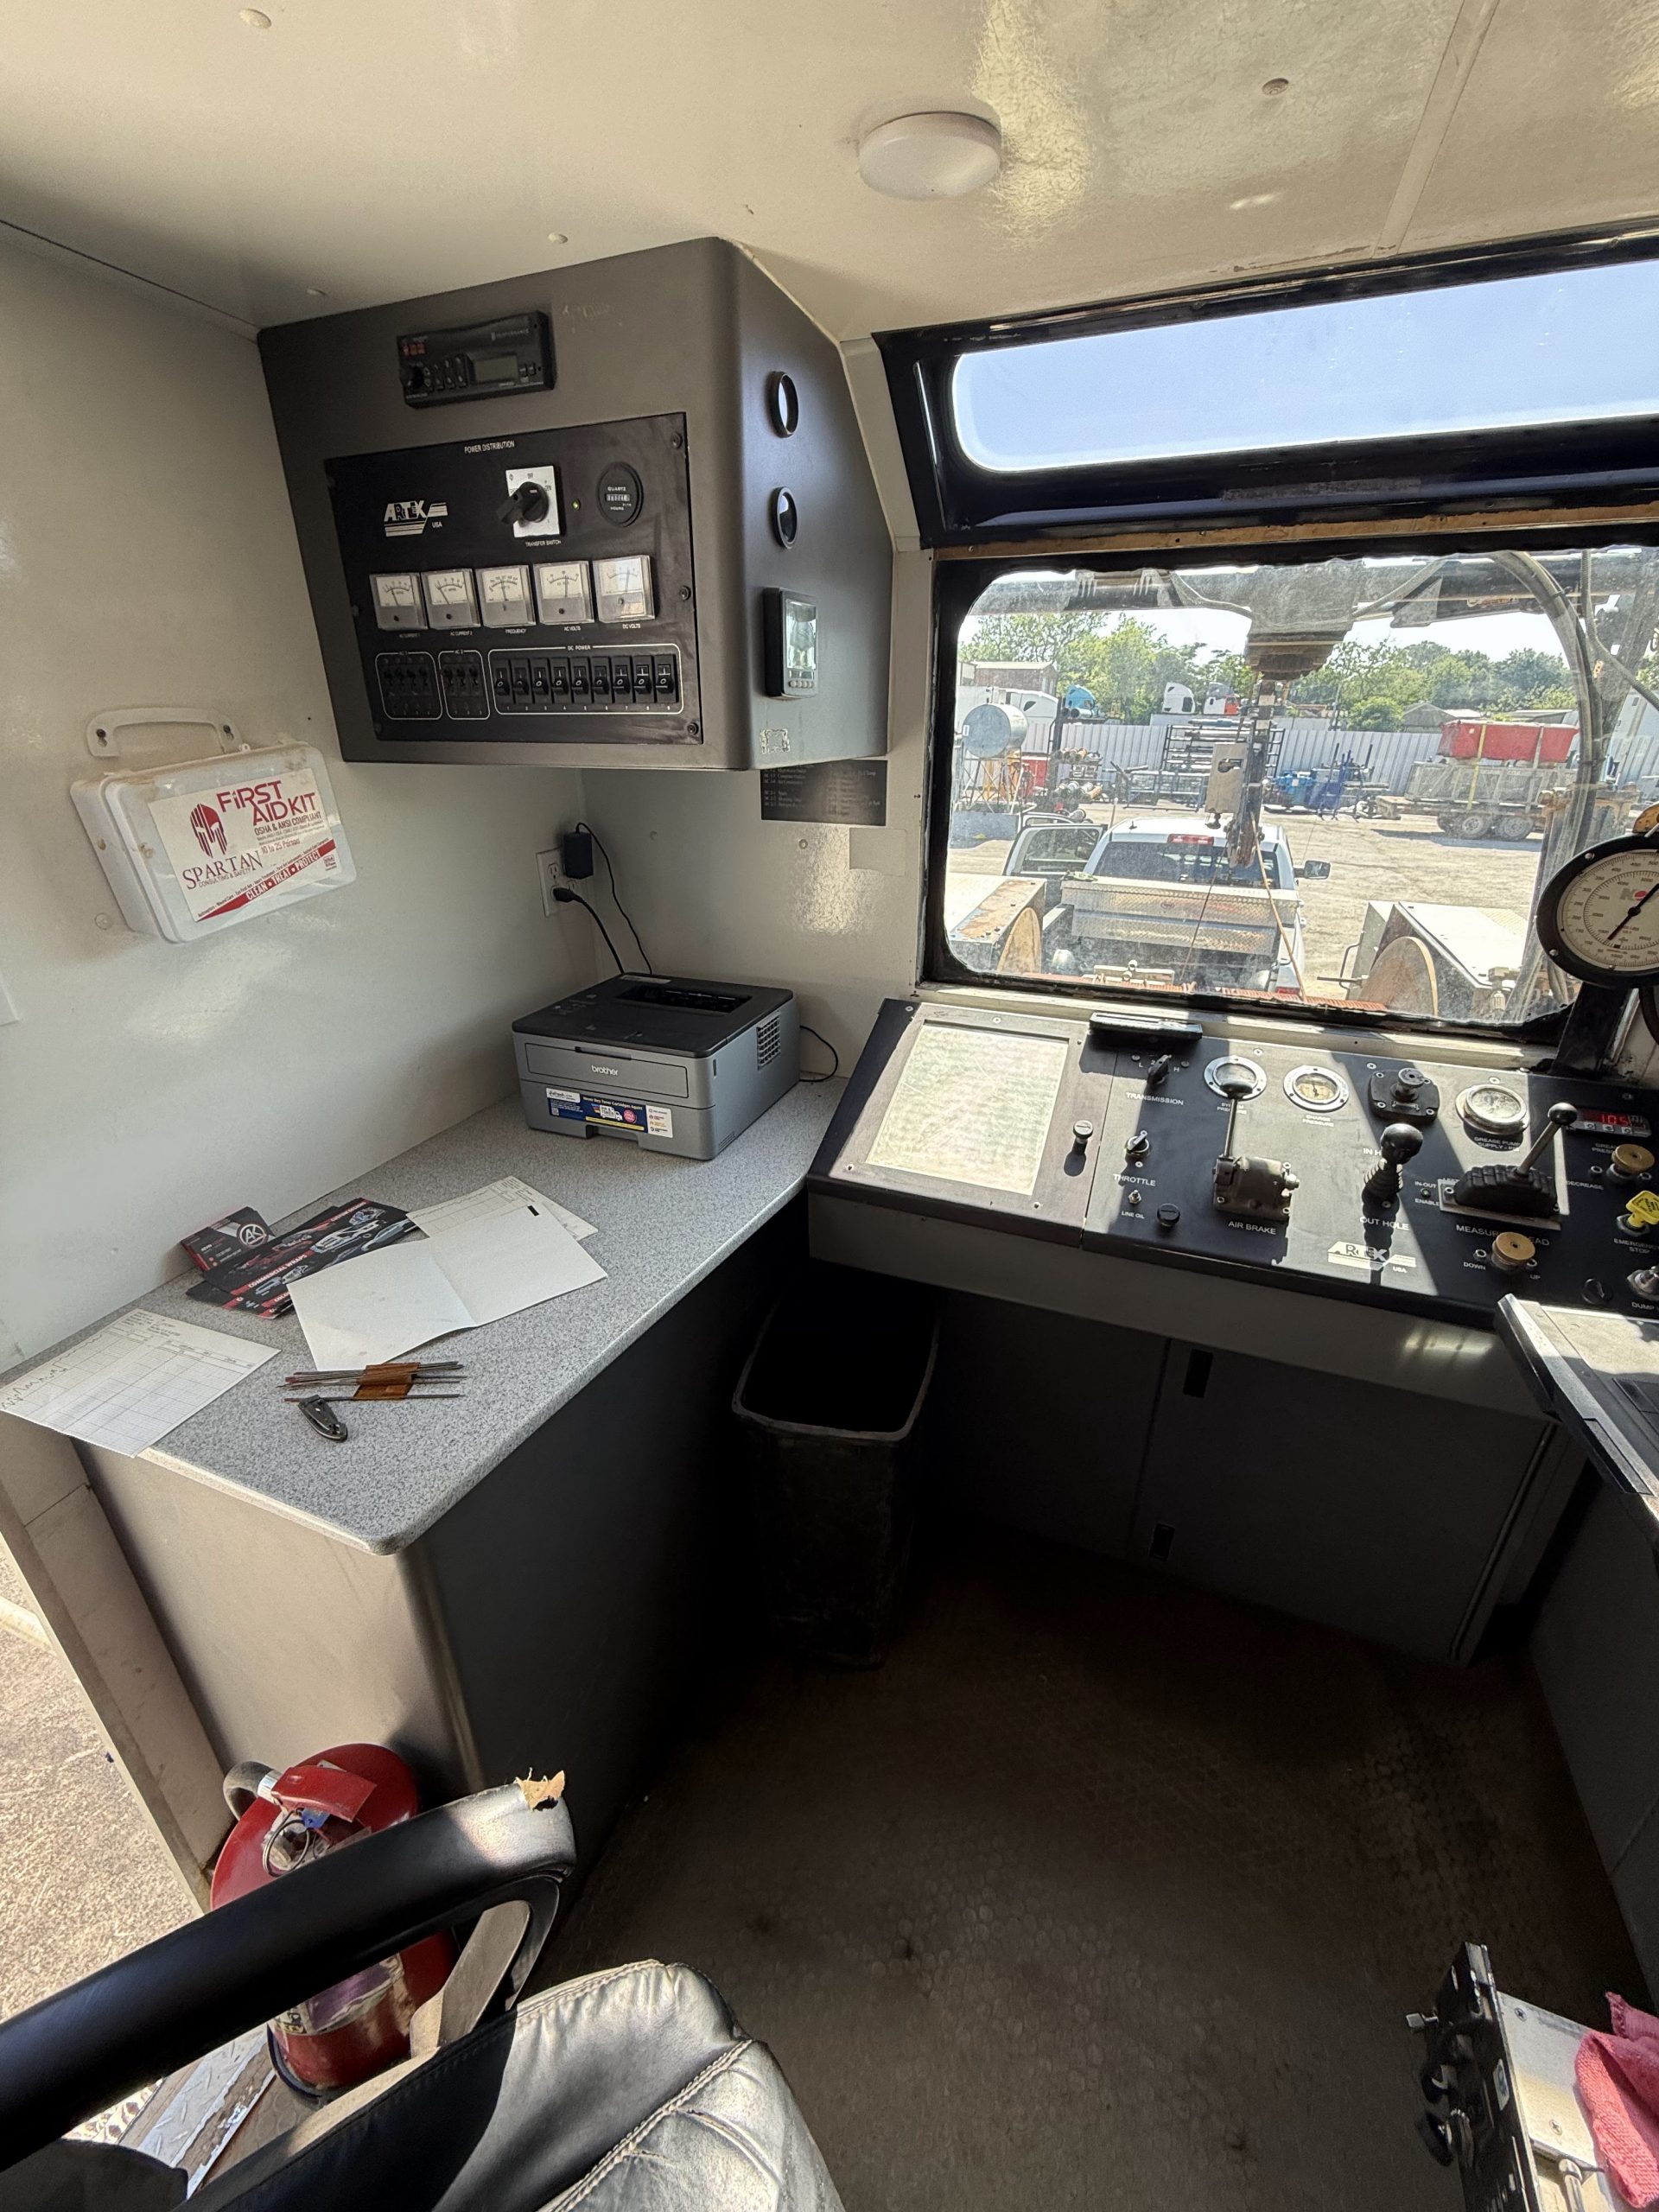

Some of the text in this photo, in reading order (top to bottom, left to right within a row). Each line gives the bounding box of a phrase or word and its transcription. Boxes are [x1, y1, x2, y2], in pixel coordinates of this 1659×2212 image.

[465, 441, 514, 454] POWER DISTRIBUTION
[384, 500, 427, 522] ARTEX
[253, 792, 315, 826] AID KIT
[255, 827, 271, 836] OSHA
[278, 820, 292, 829] ANSI
[292, 811, 321, 826] COMPLIANT
[182, 850, 263, 889] SPARTAN
[245, 881, 268, 900] CLEAN
[272, 870, 292, 886] TREAT
[296, 849, 320, 871] PROTECT
[199, 874, 228, 888] CONSULTING
[233, 868, 252, 877] SAFETY
[592, 1065, 619, 1076] brother
[1126, 1092, 1184, 1105] TRANSMISSION
[1303, 1119, 1334, 1128] PRESSURE
[1113, 1173, 1156, 1186] THROTTLE
[1415, 1198, 1440, 1206] ENABLE
[1246, 1224, 1276, 1235] BRAKE
[1360, 1217, 1410, 1230] OUT HOLE
[1456, 1224, 1499, 1236] MEASUR
[248, 1254, 307, 1288] COMMERCIAL WRAPS
[1464, 1262, 1485, 1270] DOWN
[1631, 1301, 1655, 1310] DUMP
